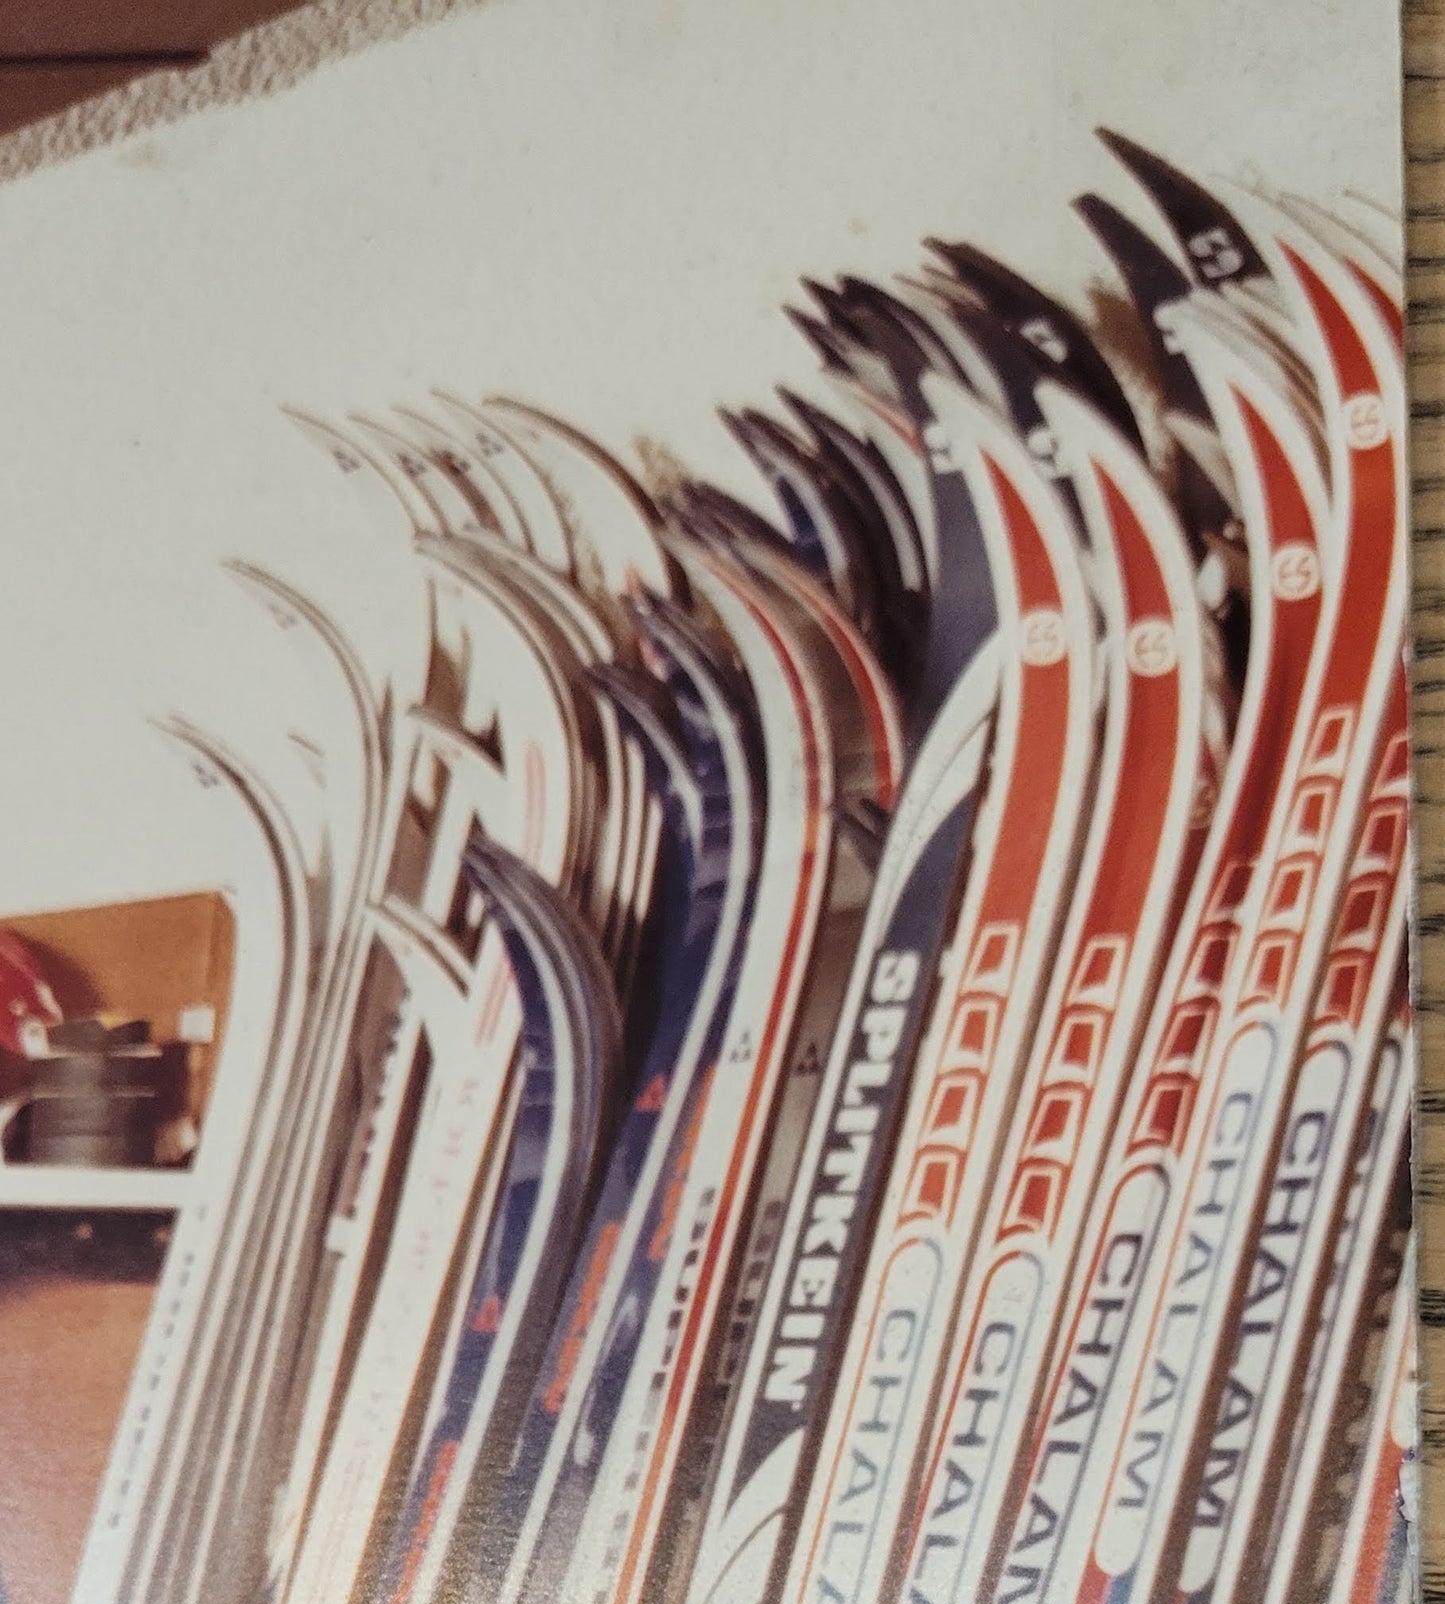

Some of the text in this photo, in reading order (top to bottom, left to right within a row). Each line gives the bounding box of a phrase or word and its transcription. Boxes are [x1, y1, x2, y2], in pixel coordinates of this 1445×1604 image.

[765, 951, 920, 1404] SPLITKEIN
[1118, 1092, 1253, 1507] CHALAM
[1191, 1110, 1328, 1529] CHALAM
